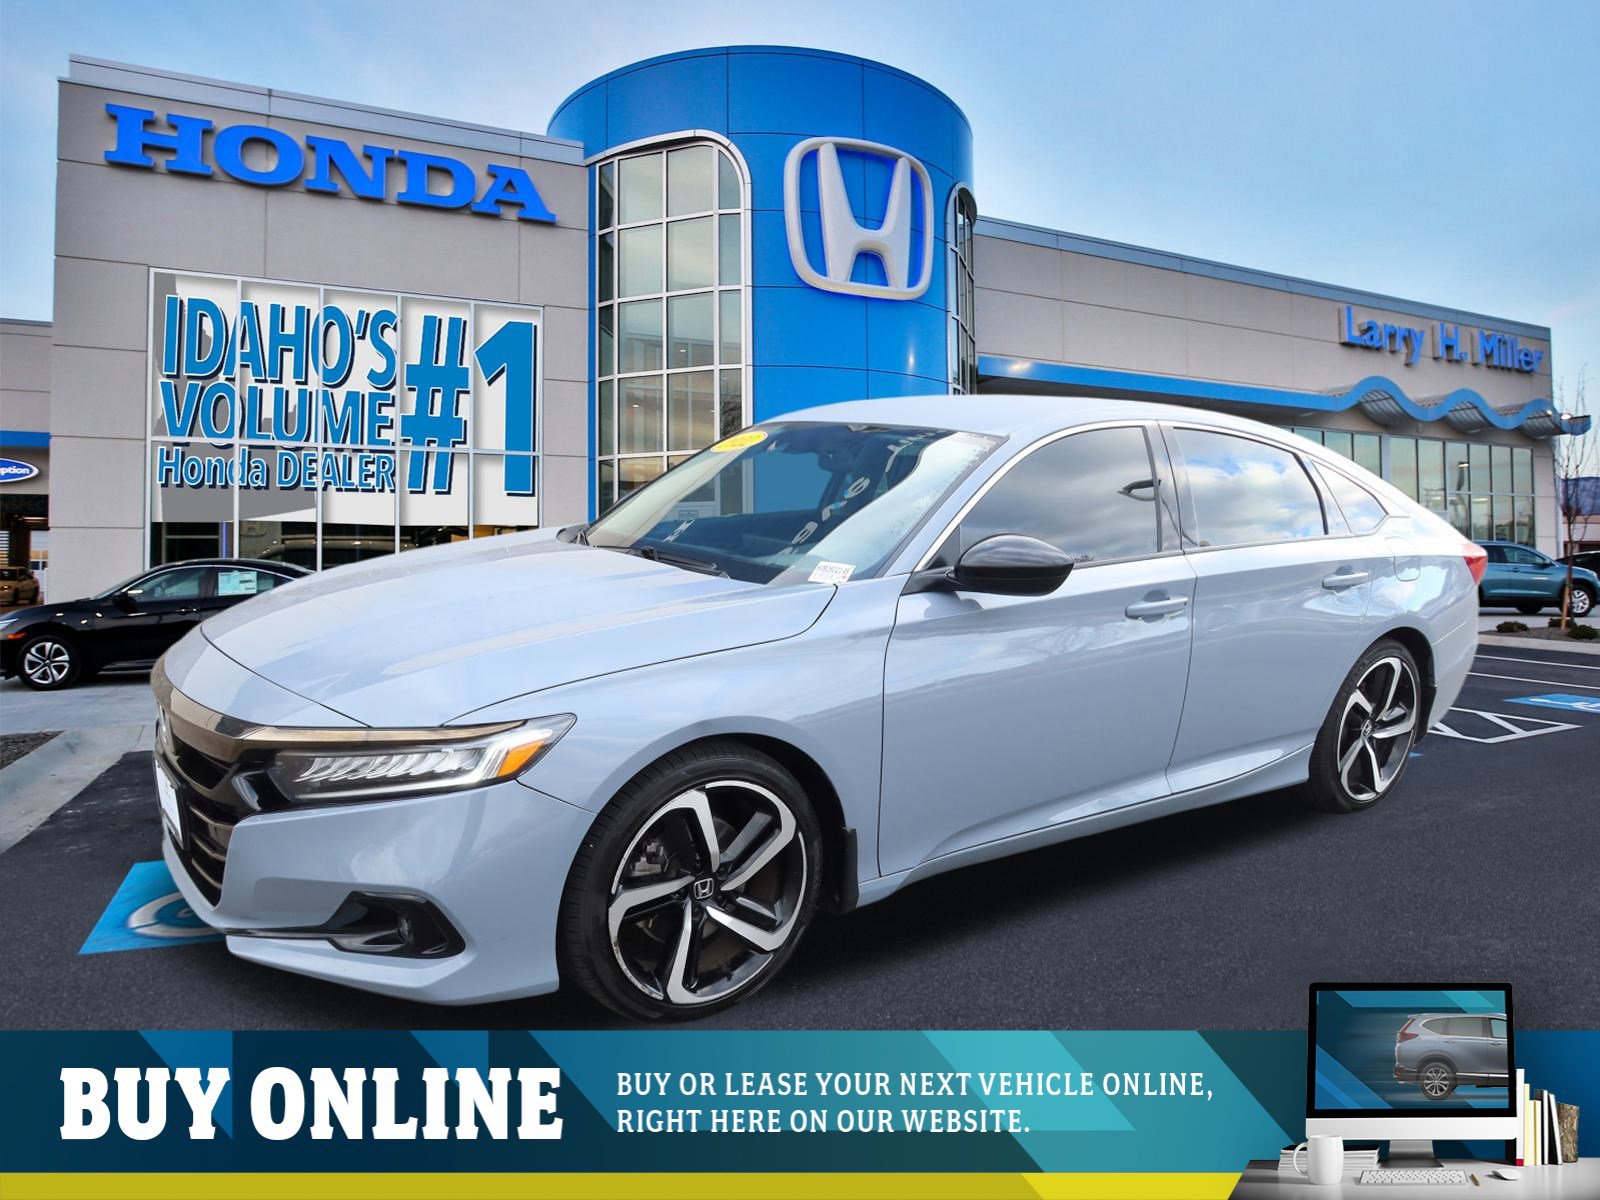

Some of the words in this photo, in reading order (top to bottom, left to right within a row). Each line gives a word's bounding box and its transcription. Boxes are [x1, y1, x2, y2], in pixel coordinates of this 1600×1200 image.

[104, 103, 557, 223] HONDA
[162, 294, 398, 389] IDAHO'S
[1342, 305, 1424, 366] Larry
[1436, 323, 1469, 363] H.
[1478, 330, 1545, 374] Miller
[158, 381, 396, 450] VOLUME
[401, 315, 538, 496] #1
[0, 465, 30, 476] ption
[156, 446, 267, 489] Honda
[276, 451, 396, 493] DEALER
